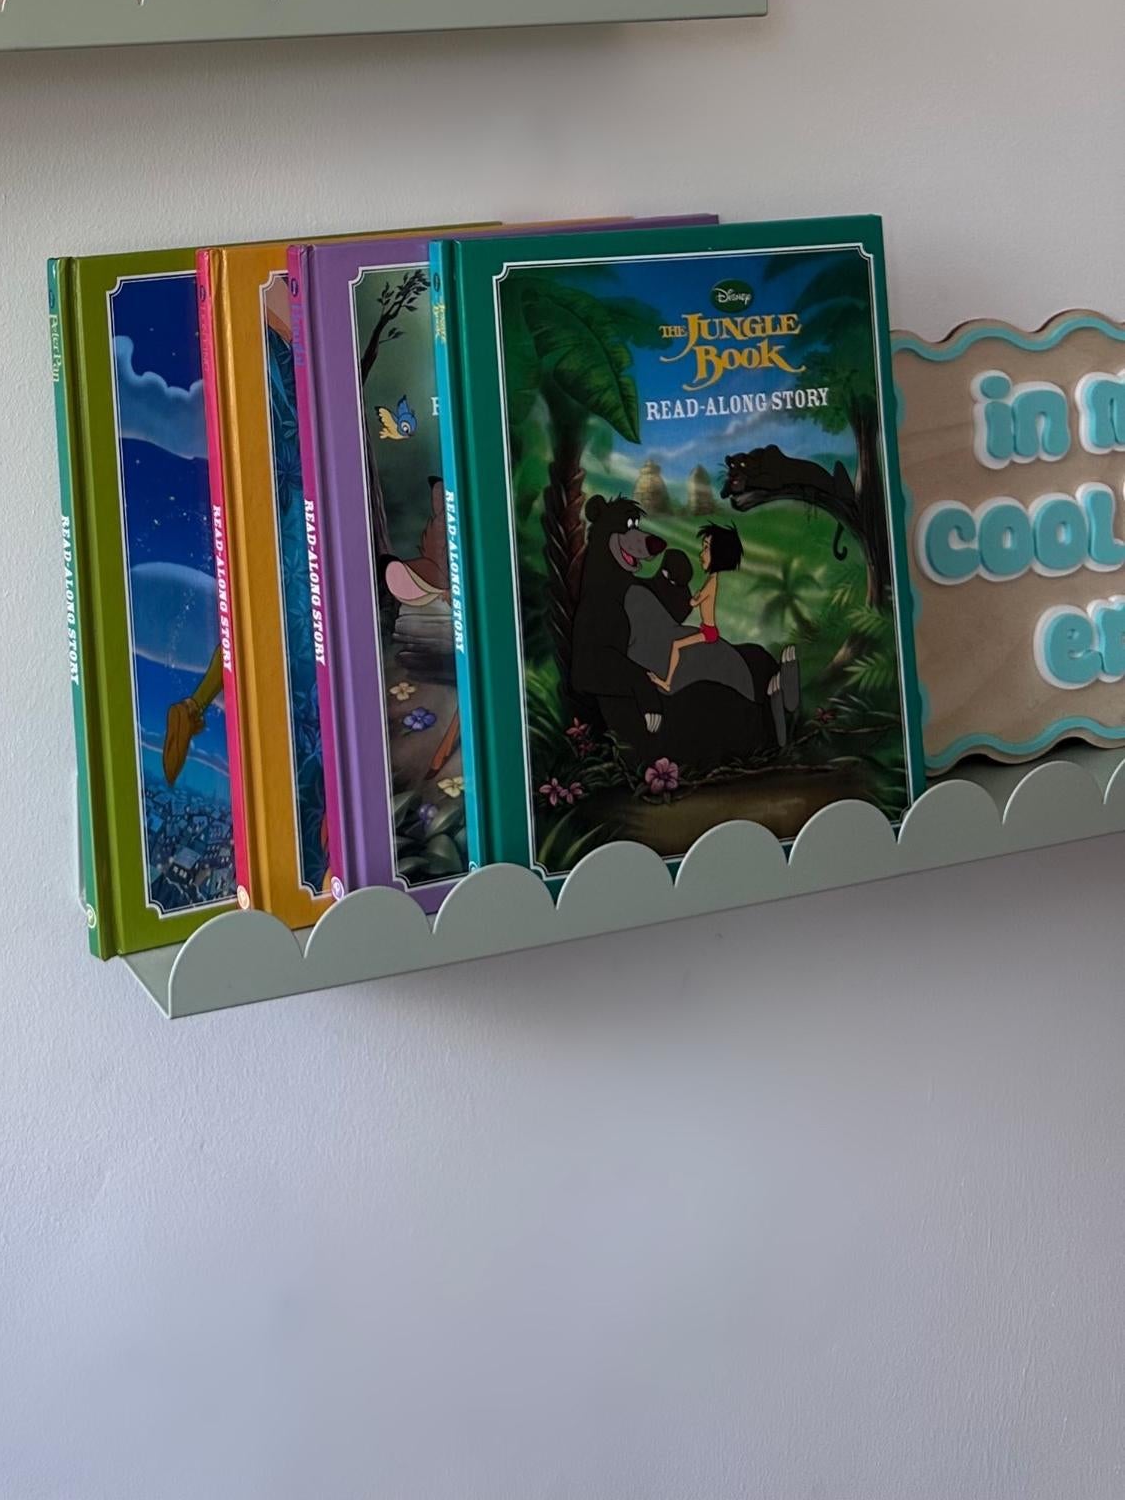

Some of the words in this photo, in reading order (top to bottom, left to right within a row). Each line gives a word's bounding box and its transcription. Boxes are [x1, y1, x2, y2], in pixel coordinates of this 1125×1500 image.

[659, 324, 688, 338] THE
[659, 313, 802, 363] JUNGLE
[645, 392, 767, 420] READ-ALONG
[771, 387, 830, 410] STORY
[977, 372, 1071, 463] in
[213, 504, 228, 612] READ-ALONG
[304, 499, 321, 606] READ-ALONG
[444, 490, 461, 596] READ-ALONG
[60, 515, 75, 624] READ-ALONG
[68, 627, 80, 686] STORY
[452, 598, 465, 654] STORY
[220, 615, 232, 673] STORY
[311, 608, 326, 666] STORY
